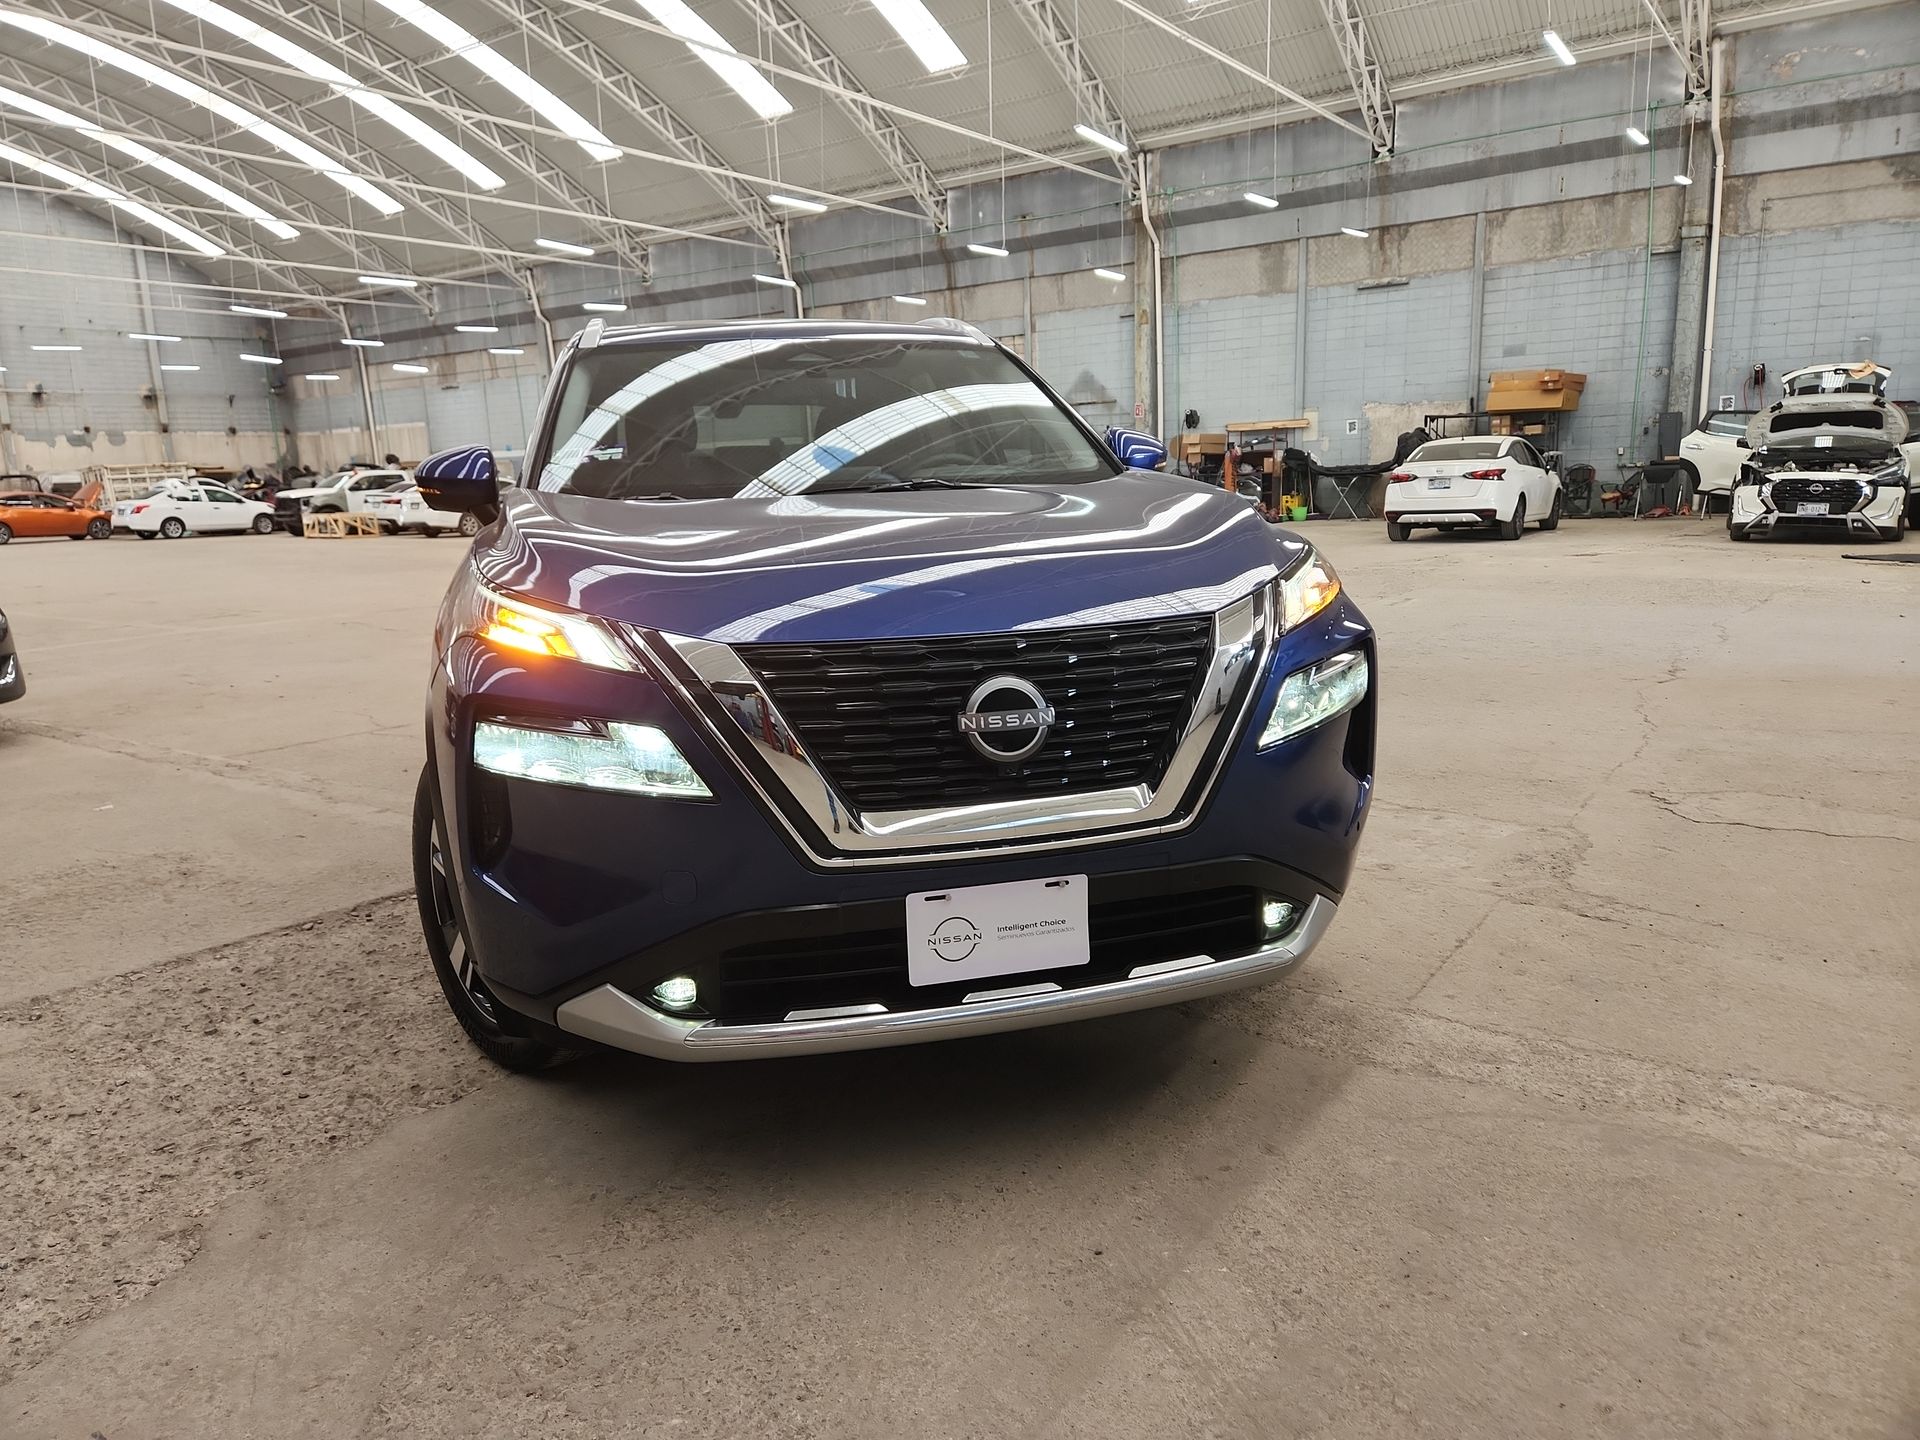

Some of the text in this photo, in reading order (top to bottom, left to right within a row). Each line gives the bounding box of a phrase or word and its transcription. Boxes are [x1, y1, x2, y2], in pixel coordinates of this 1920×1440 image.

[961, 710, 1053, 730] NISSAN
[997, 919, 1067, 932] Intelligent Choice
[927, 932, 983, 946] NISSAN
